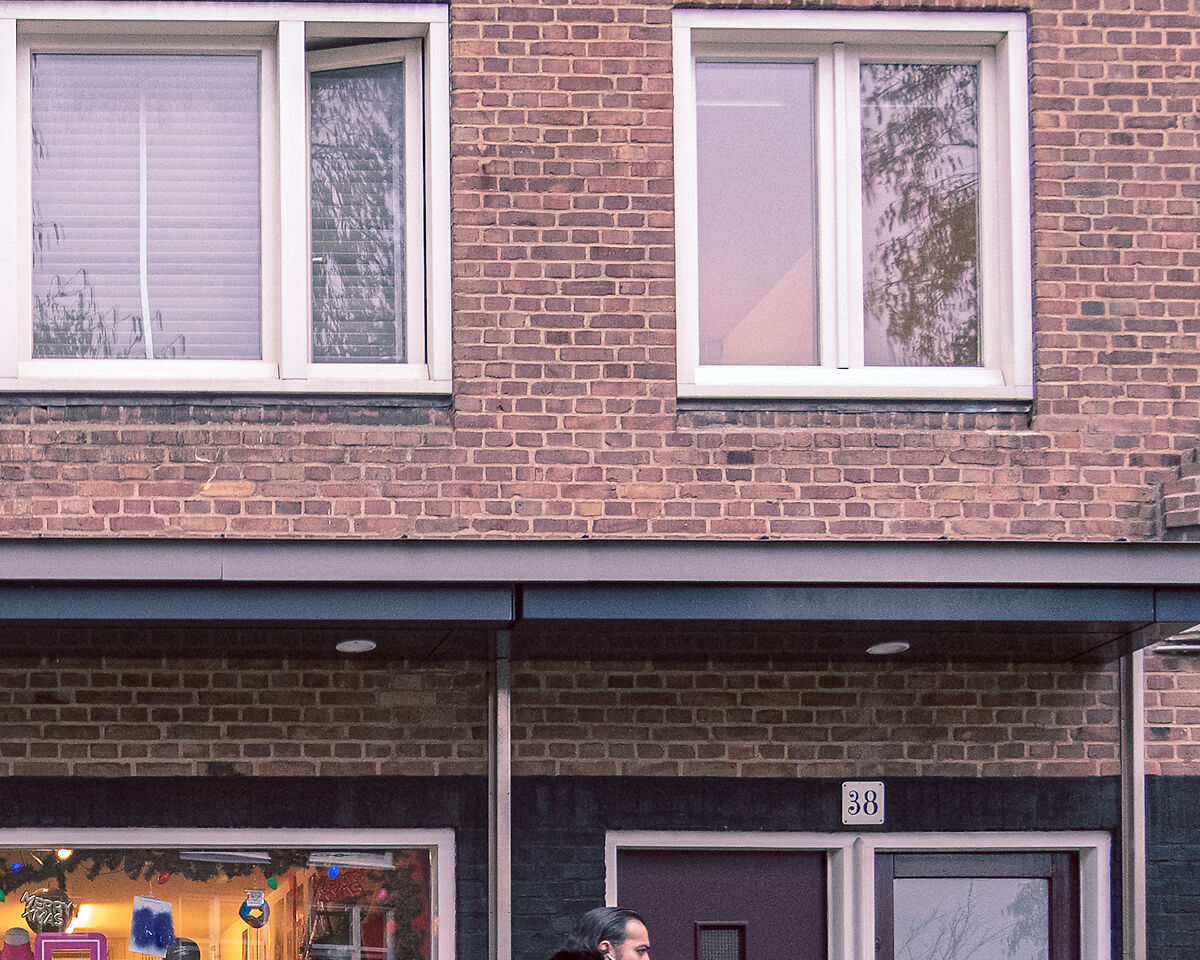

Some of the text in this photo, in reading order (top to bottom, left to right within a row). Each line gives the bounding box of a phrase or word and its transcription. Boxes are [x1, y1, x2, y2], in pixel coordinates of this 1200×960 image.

[848, 790, 878, 815] 38
[20, 890, 72, 912] MERRY
[21, 908, 64, 926] XMAS
